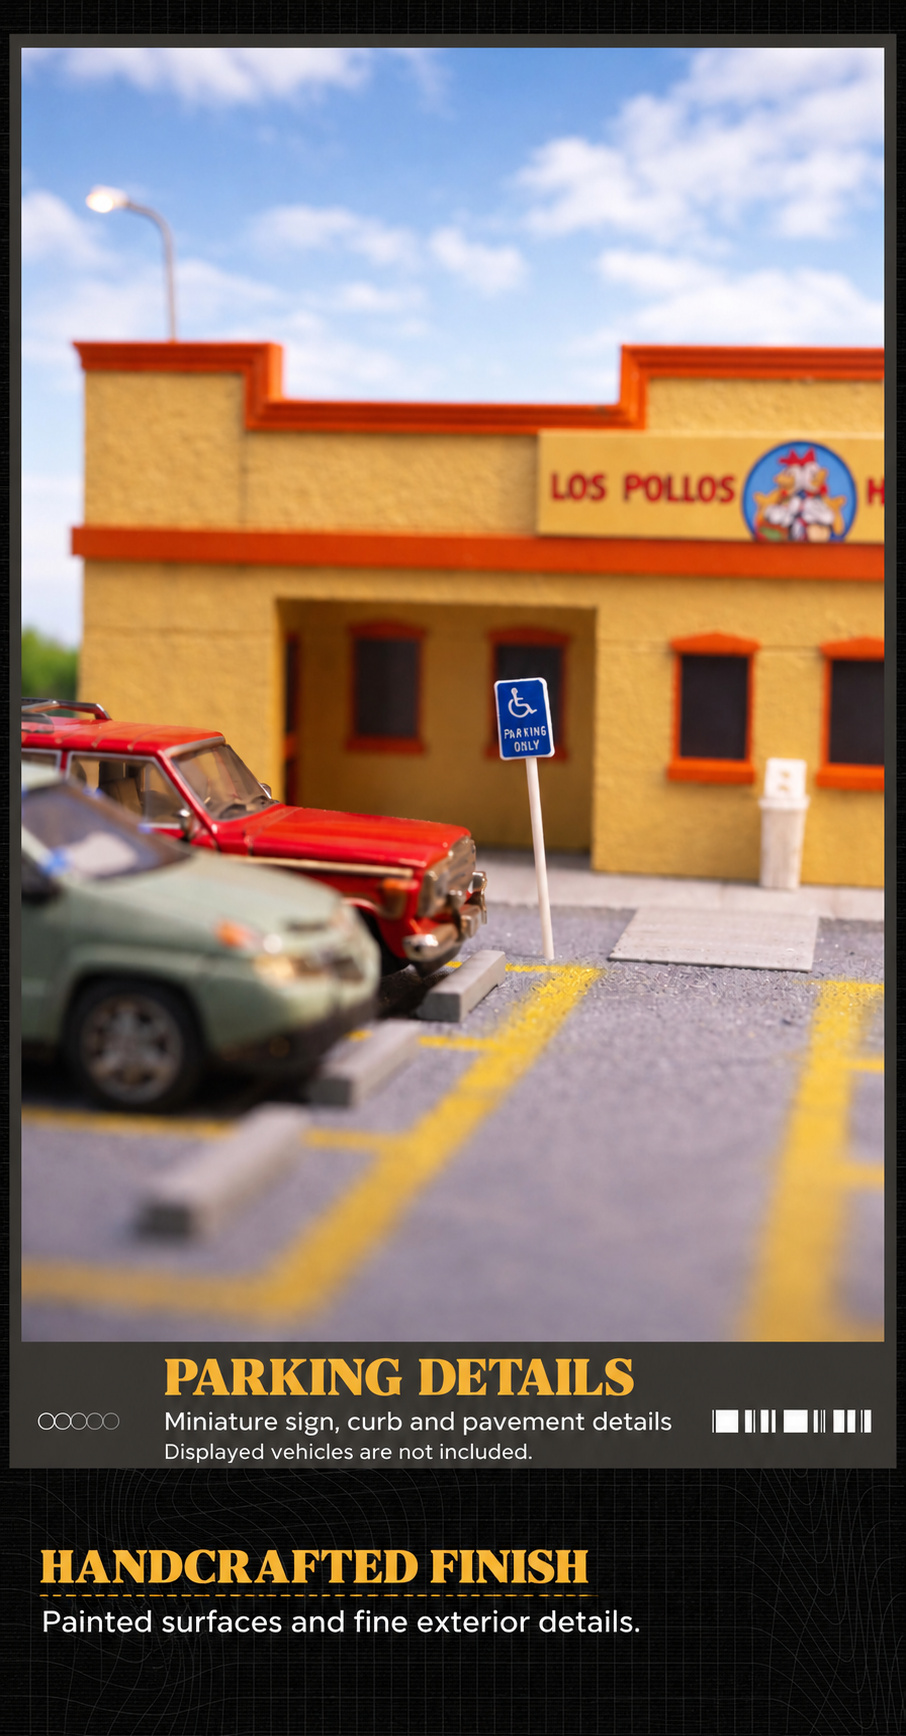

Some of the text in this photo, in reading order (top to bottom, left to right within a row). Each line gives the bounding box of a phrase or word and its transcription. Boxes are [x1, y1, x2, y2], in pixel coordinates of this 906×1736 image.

[552, 473, 607, 501] LOS
[623, 474, 735, 504] POLLOS
[504, 726, 547, 739] PARKING
[514, 739, 540, 752] ONLY
